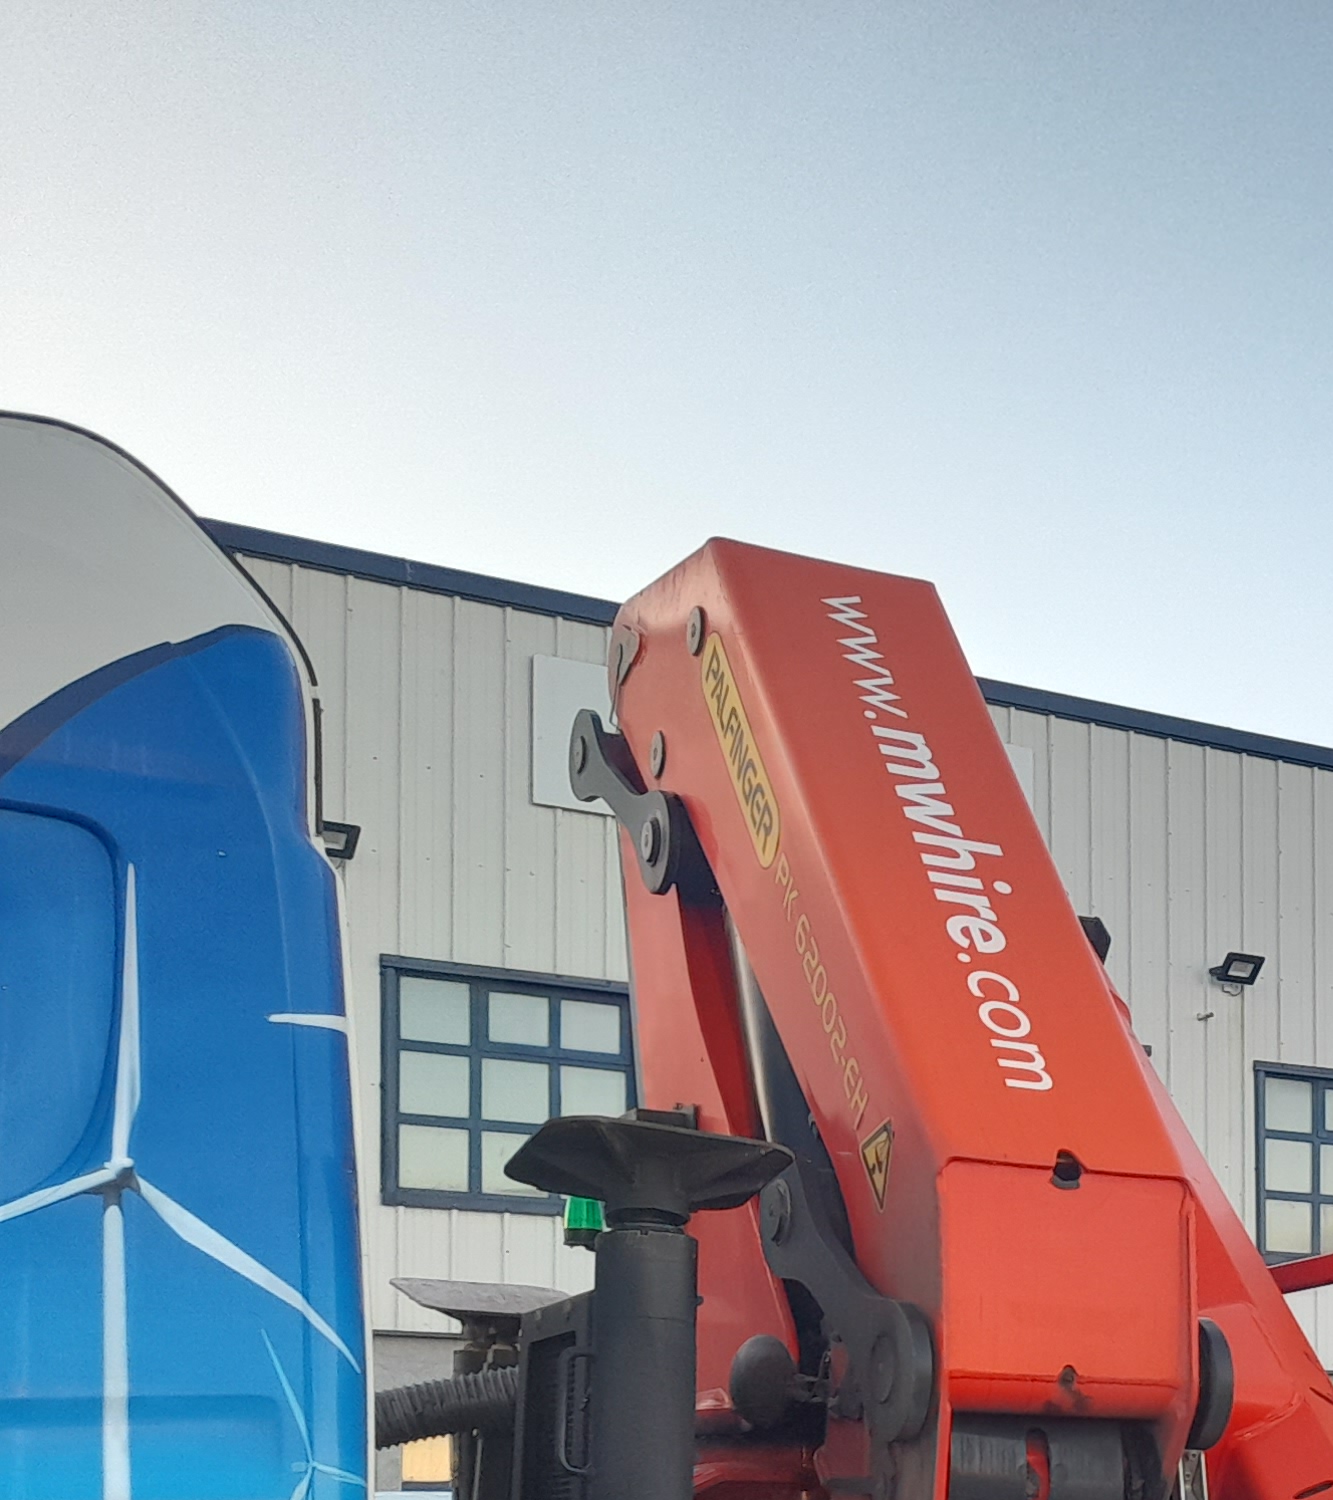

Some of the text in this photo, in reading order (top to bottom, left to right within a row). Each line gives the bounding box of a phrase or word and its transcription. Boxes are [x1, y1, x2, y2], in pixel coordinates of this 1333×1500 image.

[705, 644, 774, 856] PALFINGER
[820, 595, 1053, 1092] www.mwhire.com
[774, 852, 869, 1131] PK 62002-EH
